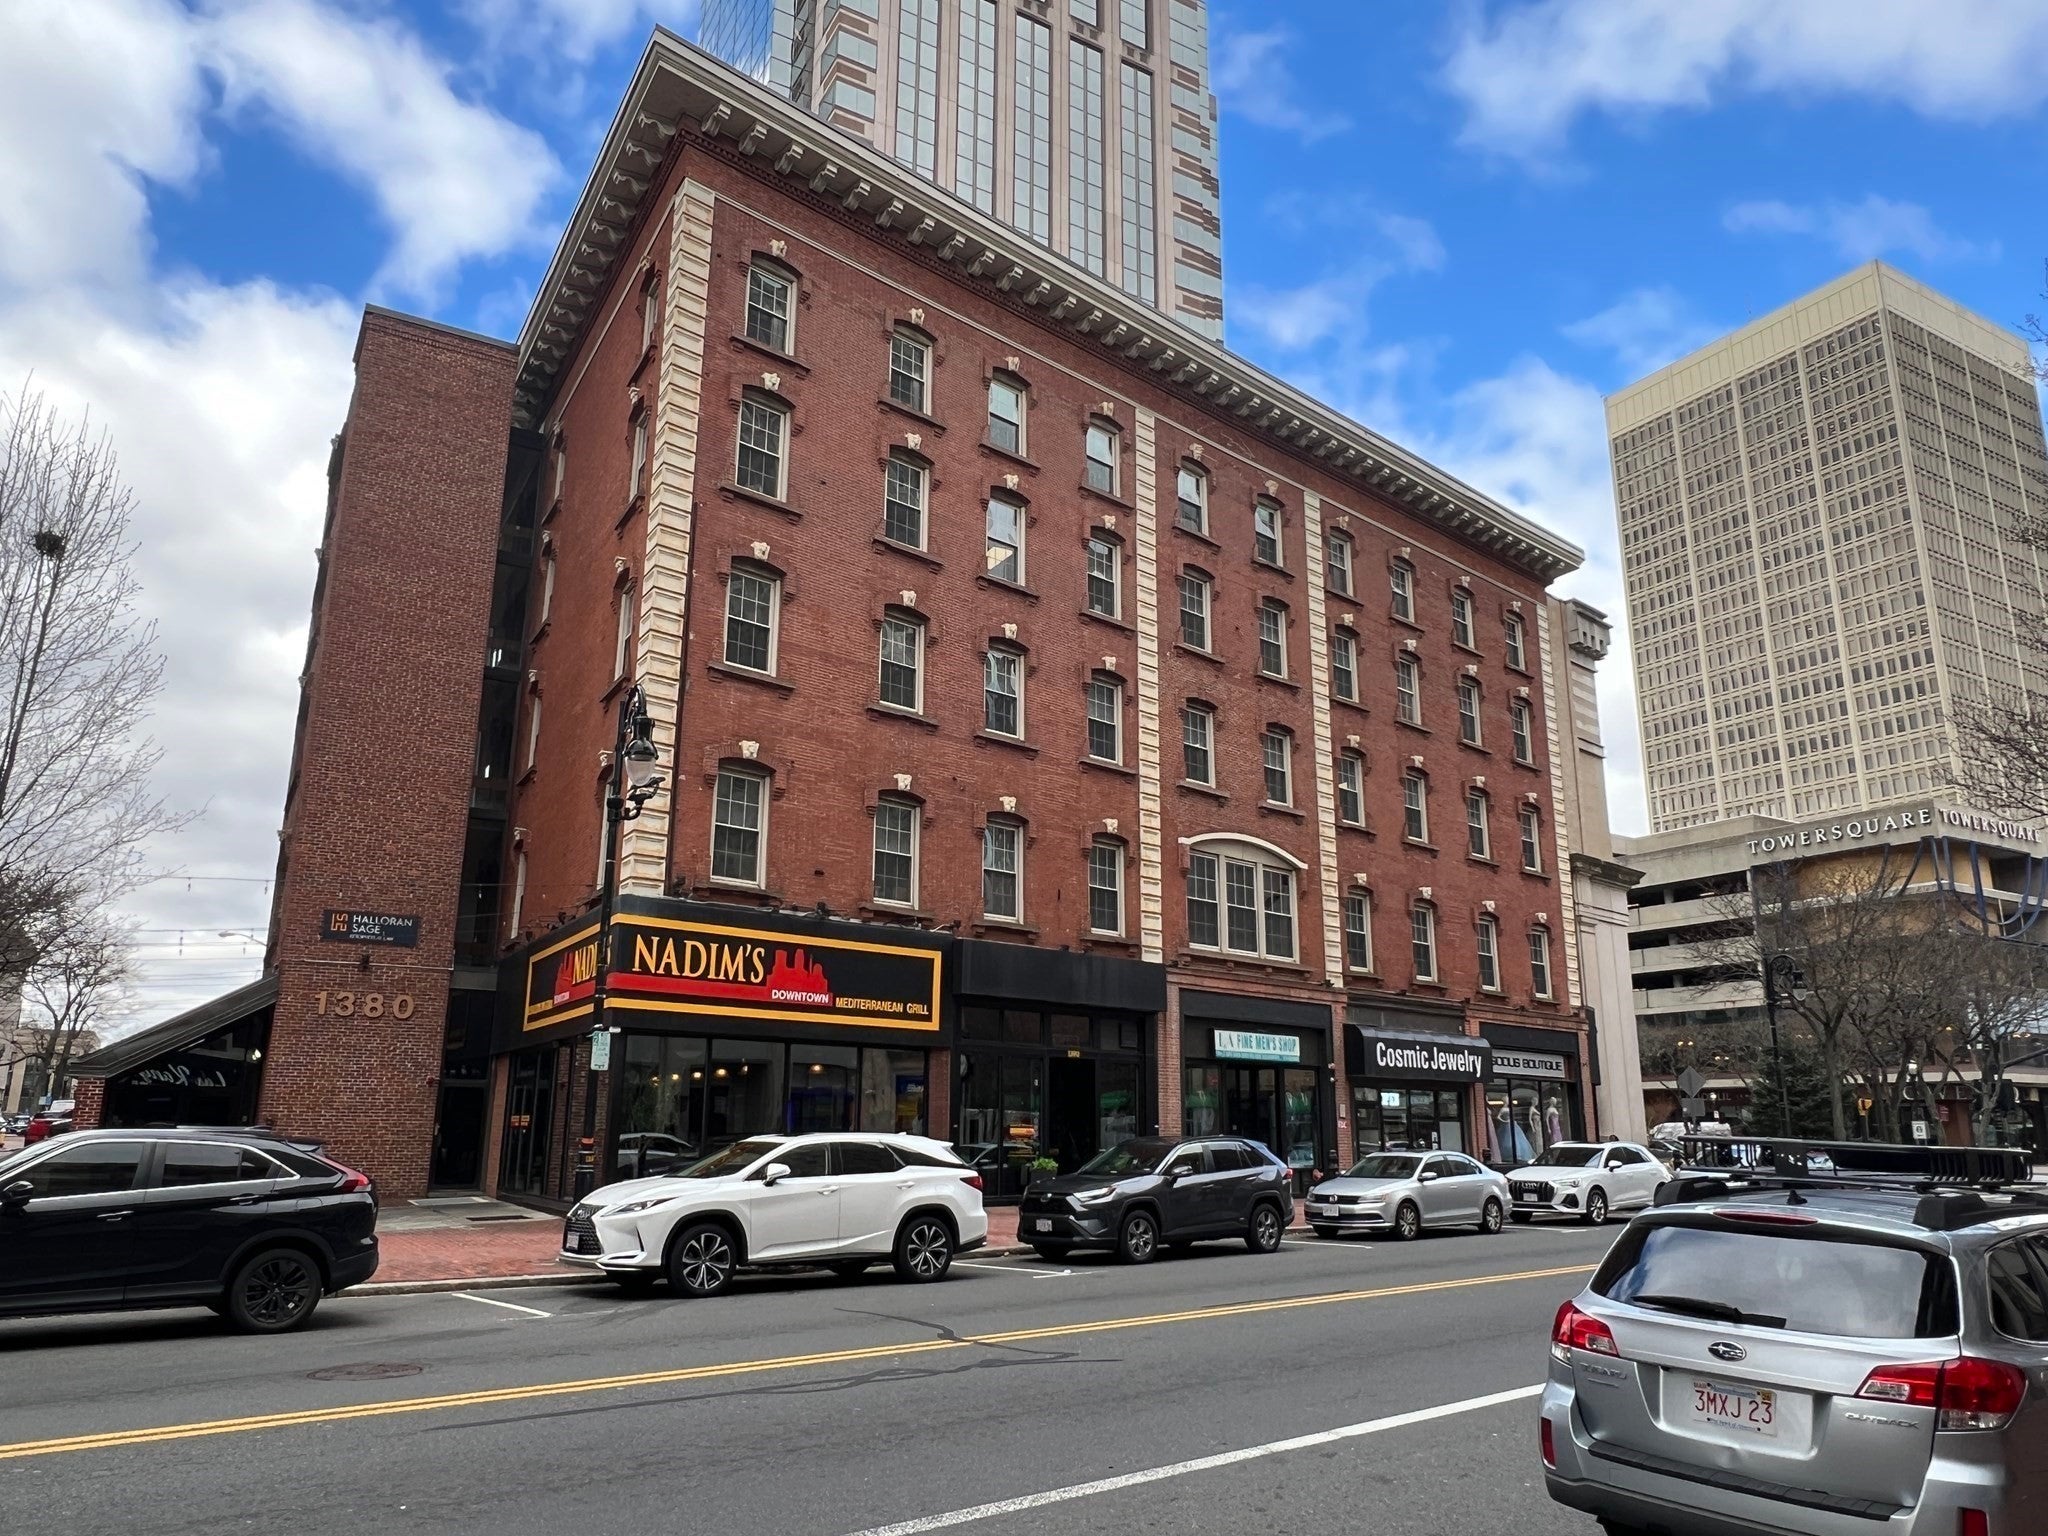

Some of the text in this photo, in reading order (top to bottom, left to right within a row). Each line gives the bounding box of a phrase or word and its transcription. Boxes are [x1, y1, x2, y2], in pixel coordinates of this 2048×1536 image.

[1747, 808, 1932, 855] TOWERSQUARE
[1939, 808, 2042, 843] TOWERSQUARE
[352, 914, 413, 927] HALLORAN
[352, 923, 381, 934] SAGE
[631, 933, 766, 984] NADIM'S
[314, 990, 416, 1020] 1380
[771, 989, 829, 1004] DOWNTOWN
[835, 997, 929, 1015] MEDITERRANEAN GRILL
[1376, 1041, 1482, 1078] Cosmic Jewelry
[1522, 1058, 1563, 1072] BOUTIQUE
[1695, 1389, 1772, 1425] 3MXJ 23
[1844, 1412, 1920, 1430] OUTBACK
